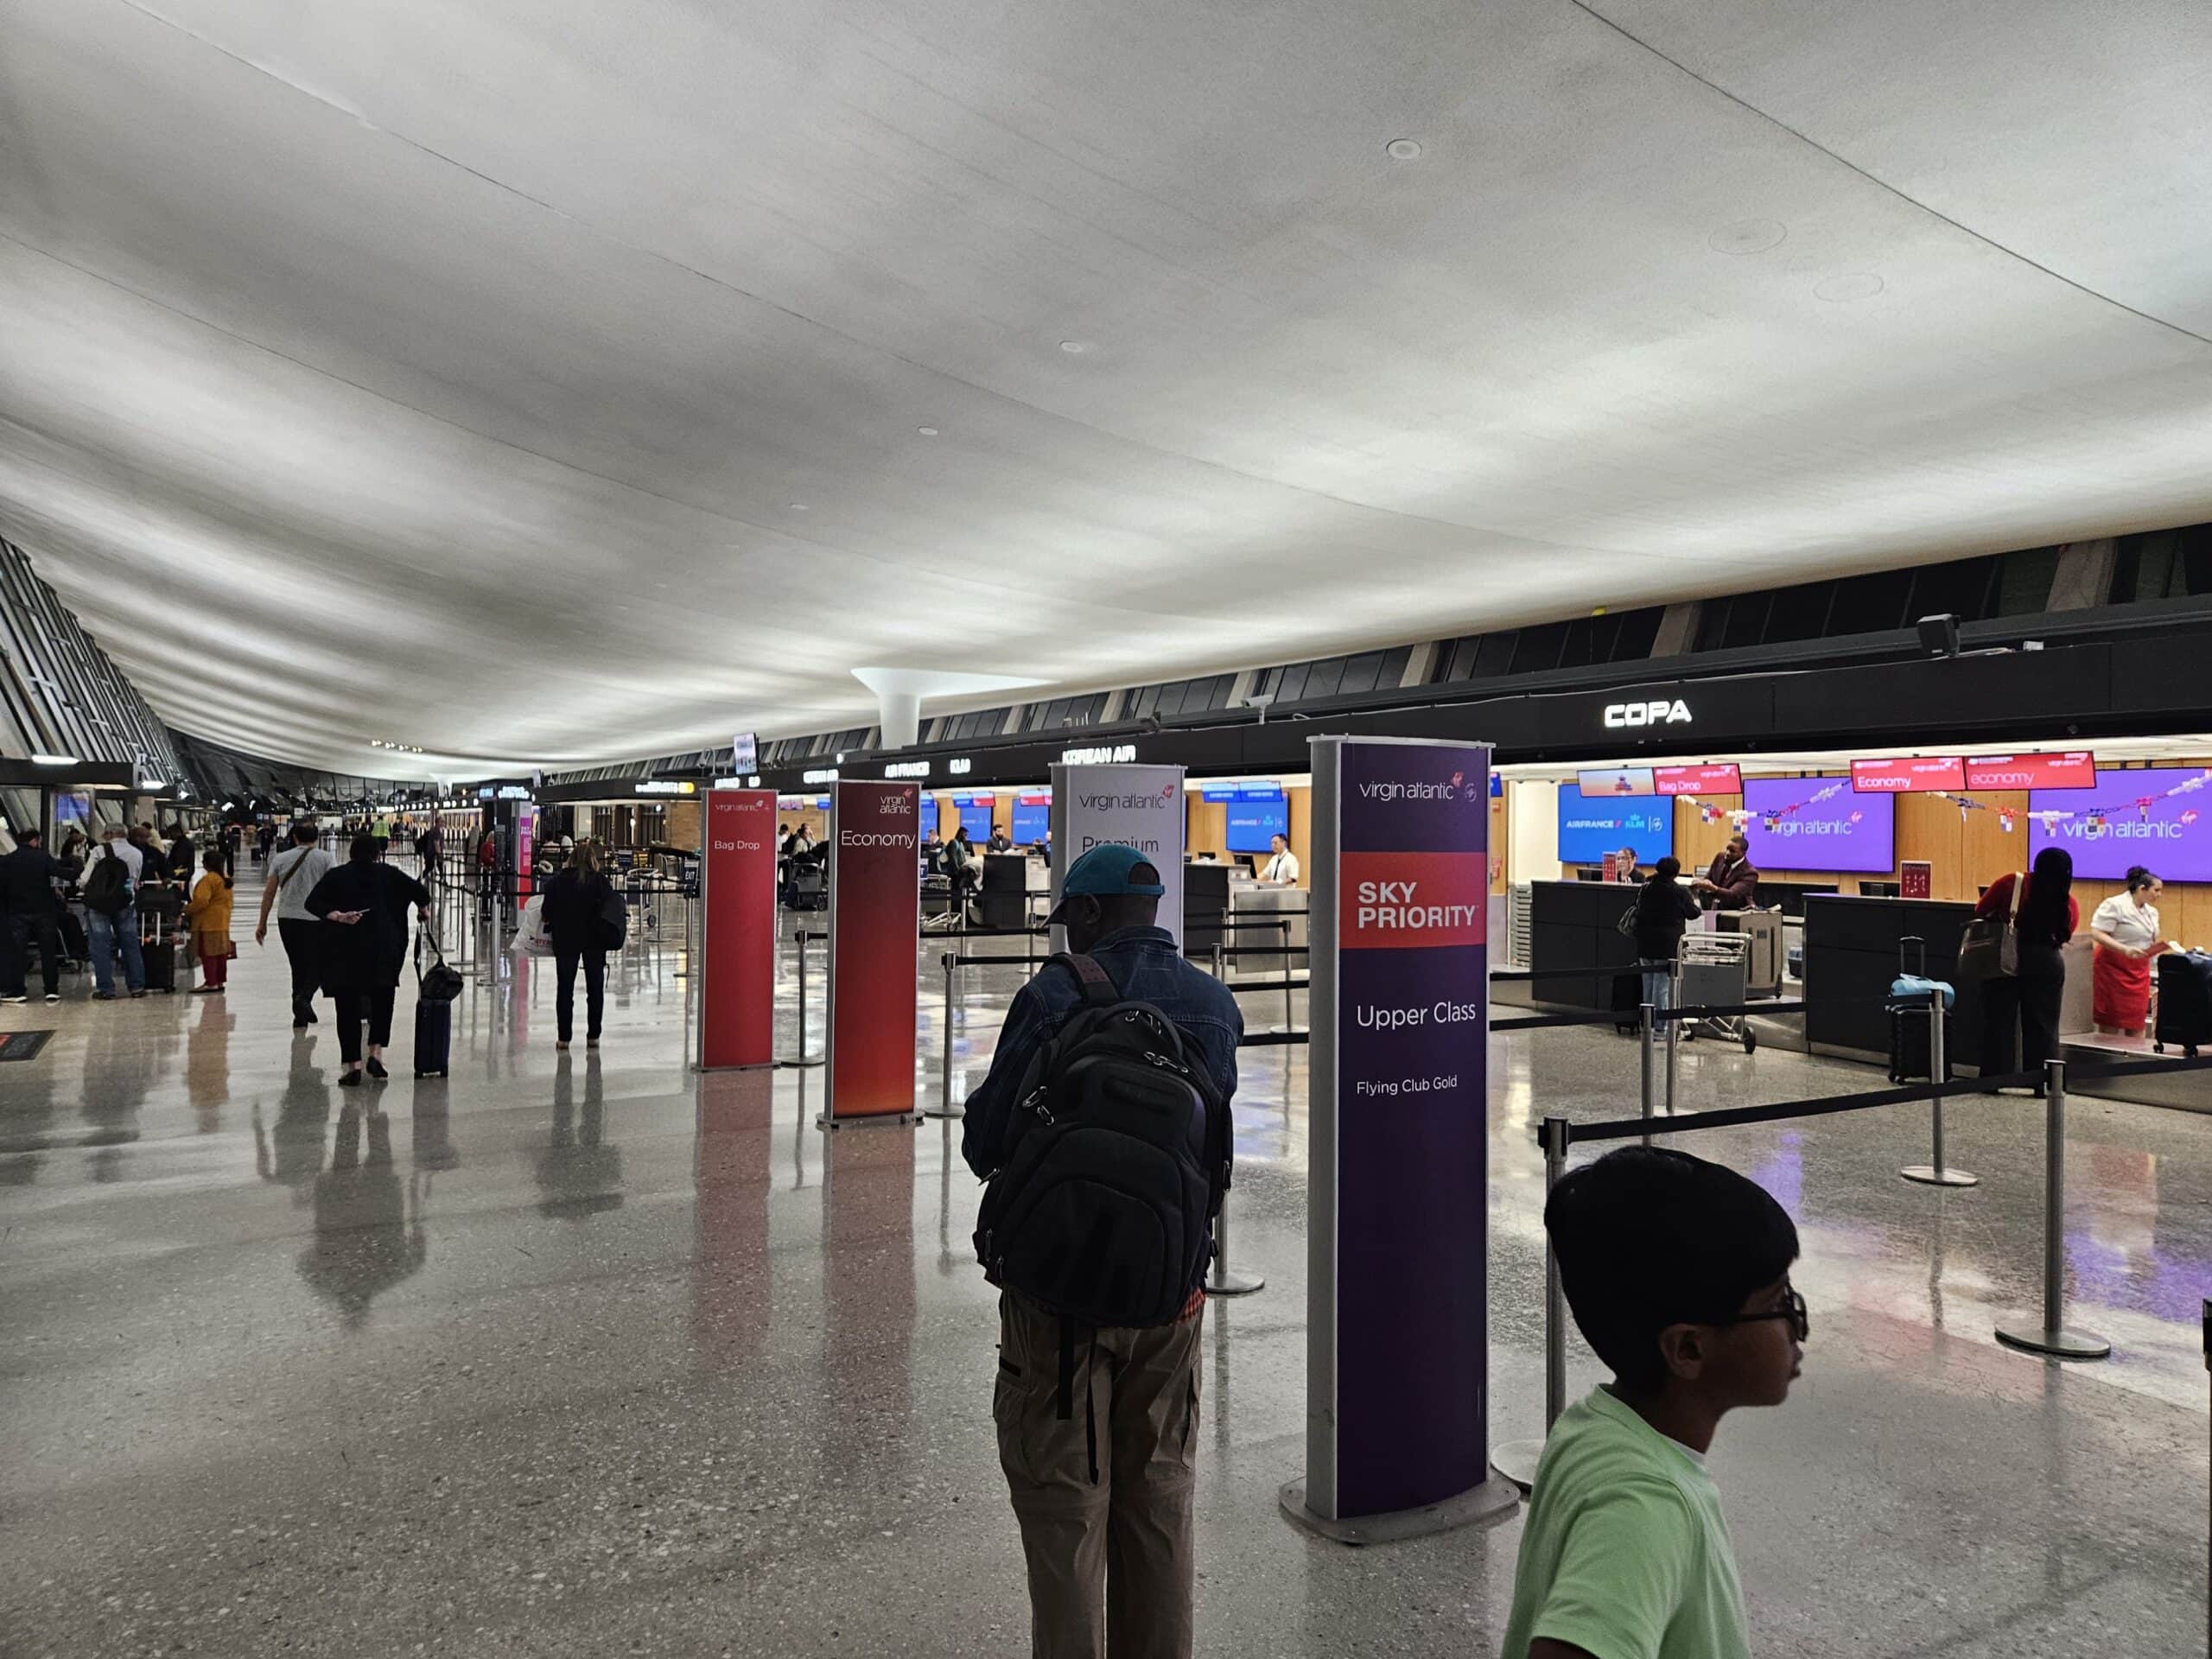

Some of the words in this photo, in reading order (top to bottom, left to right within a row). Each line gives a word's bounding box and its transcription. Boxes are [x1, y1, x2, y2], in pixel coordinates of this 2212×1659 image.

[1605, 699, 1693, 728] COPA
[1113, 745, 1136, 762] AIR
[1659, 781, 1677, 793] Bag
[1678, 780, 1700, 791] Drop
[1857, 776, 1911, 789] Economy
[1970, 772, 2034, 785] economy
[1359, 780, 1404, 802] virgin
[1407, 781, 1453, 799] atlantic
[880, 795, 906, 806] virgin
[1078, 792, 1121, 811] virgin
[1122, 793, 1165, 809] atlantic
[880, 804, 912, 815] atlantic
[1625, 820, 1645, 829] KLM
[1805, 819, 1853, 836] atlantic
[2115, 821, 2183, 839] atlantic
[714, 840, 734, 851] Bag
[737, 840, 760, 851] Drop
[841, 830, 916, 849] Economy
[685, 871, 695, 880] EXIT
[1358, 881, 1417, 905] SKY
[1357, 906, 1476, 929] PRIORITY
[1357, 1005, 1427, 1031] Upper
[1433, 1001, 1476, 1024] Class
[1357, 1080, 1398, 1096] Flying
[1402, 1078, 1430, 1093] Club
[1433, 1074, 1458, 1090] Gold
